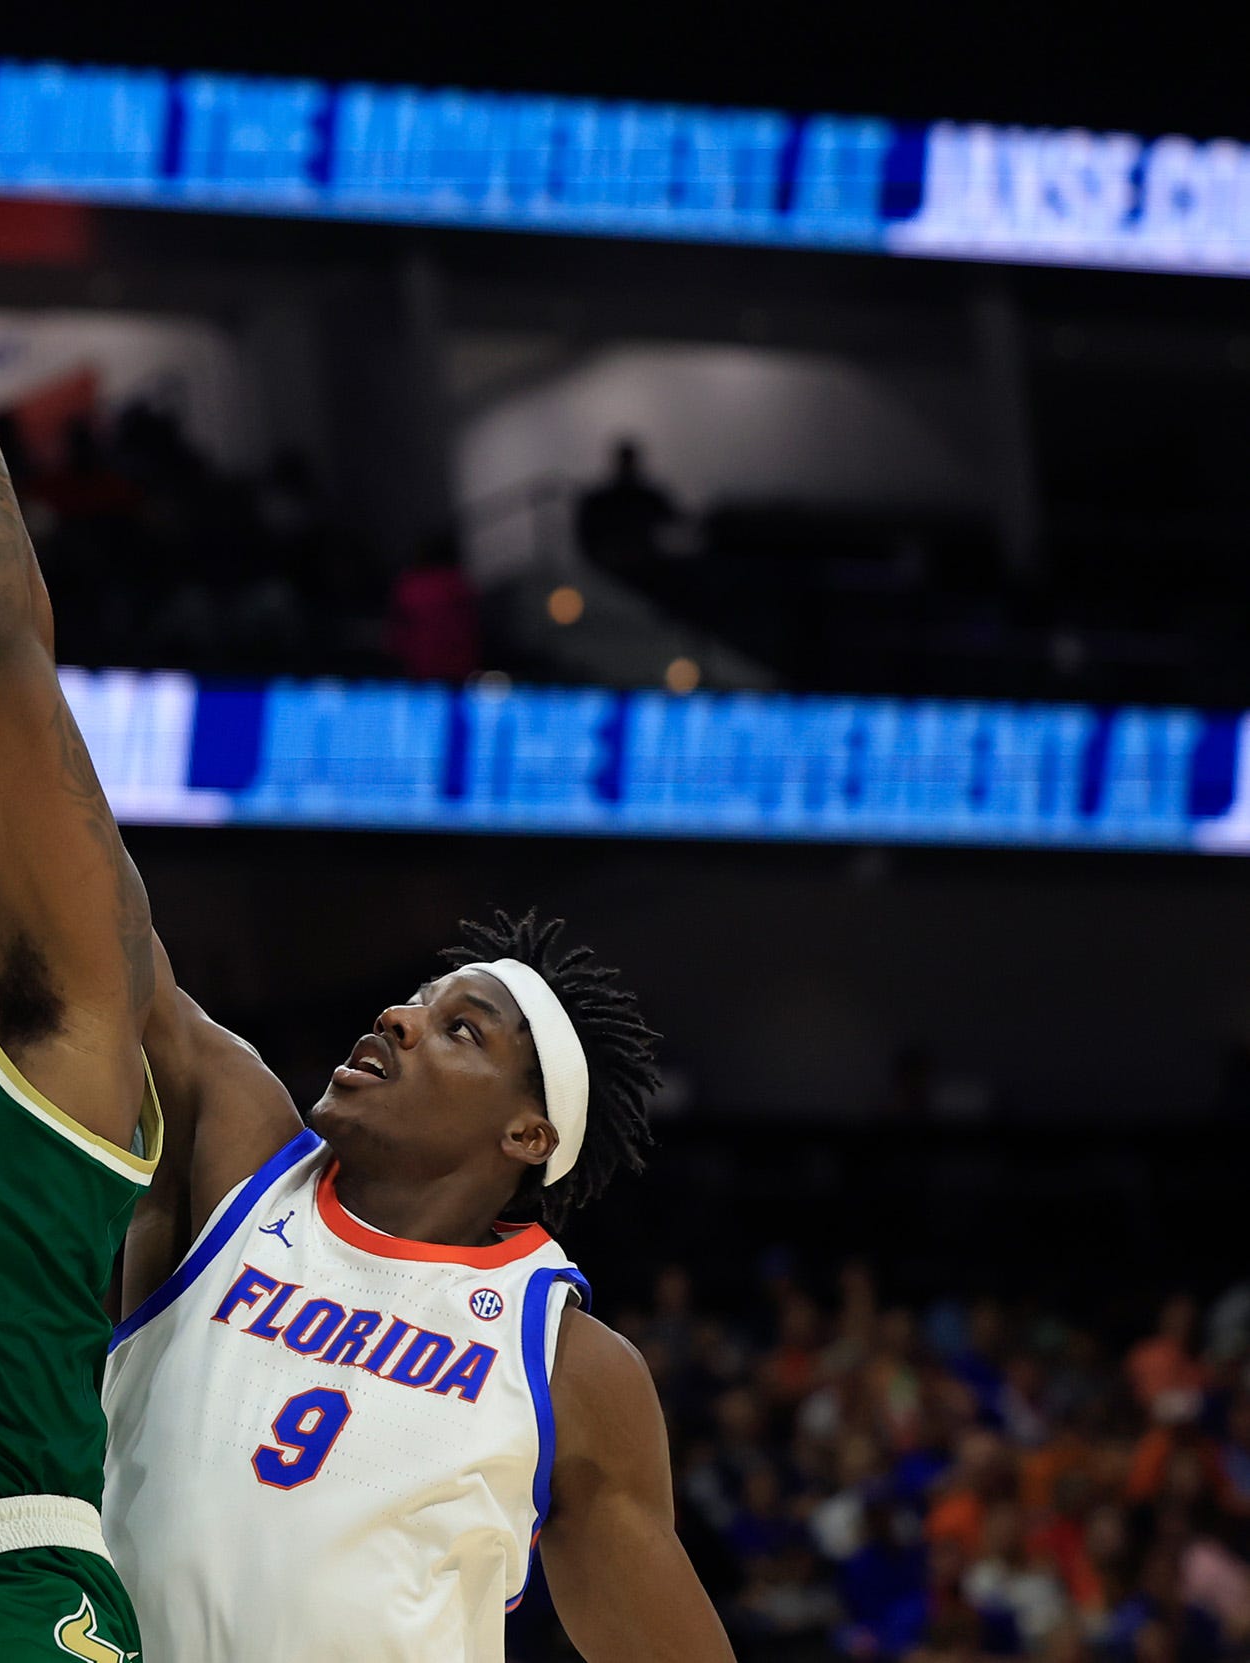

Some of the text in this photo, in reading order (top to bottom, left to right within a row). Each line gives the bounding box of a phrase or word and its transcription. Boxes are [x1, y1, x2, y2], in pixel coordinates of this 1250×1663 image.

[210, 1263, 499, 1404] FLORIDA
[470, 1289, 502, 1320] SEC
[251, 1387, 352, 1490] 9
